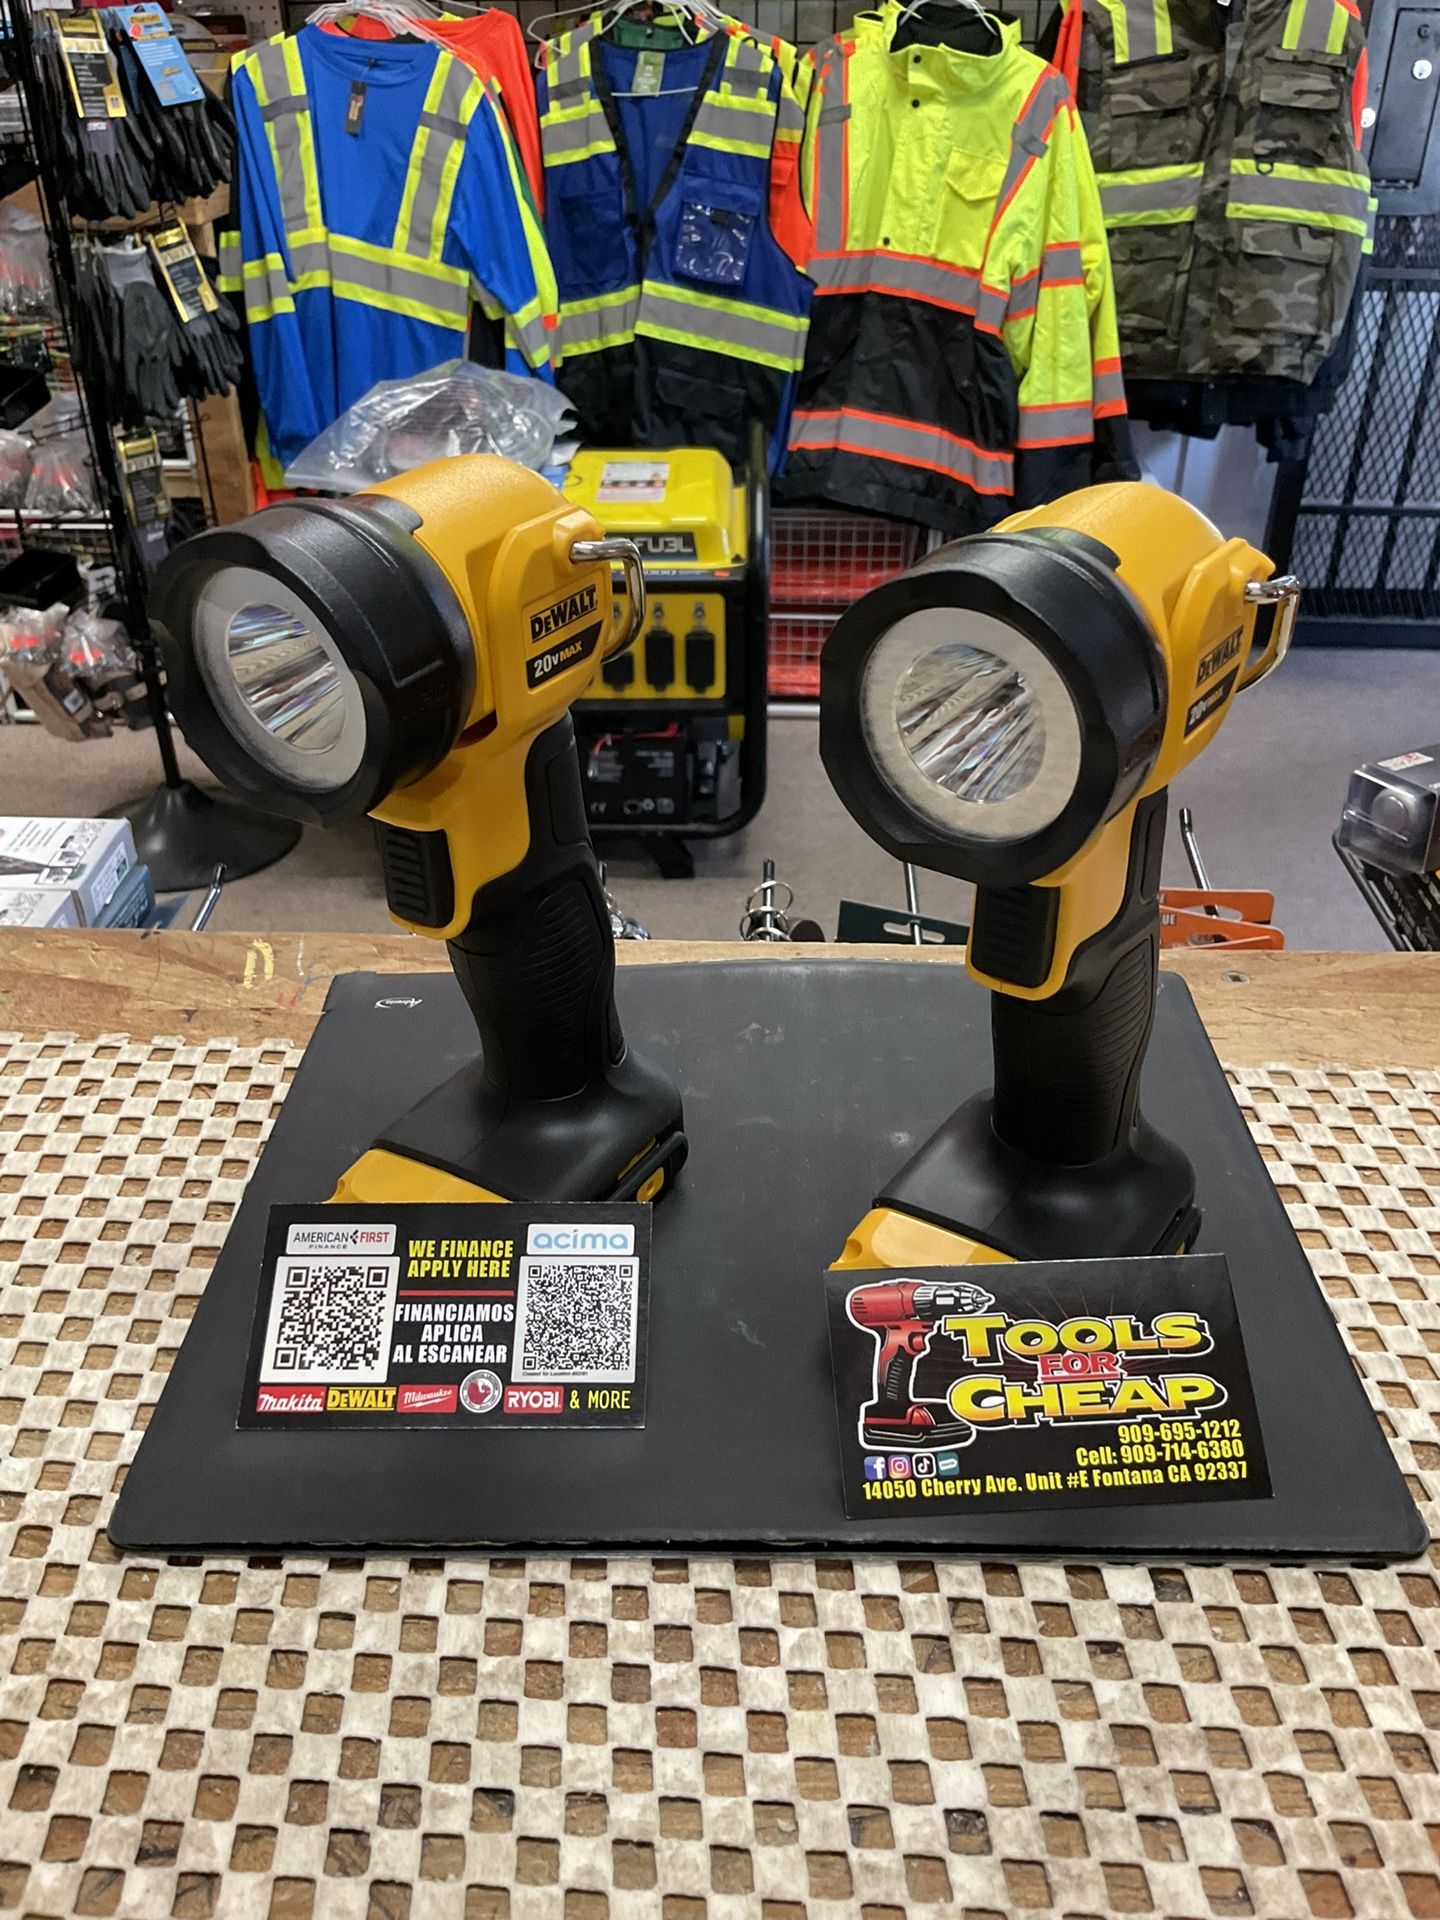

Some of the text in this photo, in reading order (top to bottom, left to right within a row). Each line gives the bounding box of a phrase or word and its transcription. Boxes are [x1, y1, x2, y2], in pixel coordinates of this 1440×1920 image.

[530, 585, 598, 642] DEWALT
[293, 1231, 390, 1243] AMERICAN FIRST
[533, 1229, 629, 1250] acima
[408, 1240, 514, 1258] WE FINANCE
[407, 1260, 511, 1278] APPLY HERE
[394, 1303, 515, 1322] FINANCIAMOS
[421, 1324, 484, 1343] APLICA
[944, 1312, 1210, 1362] TOOLS
[392, 1344, 508, 1363] AL ESCANEAR
[1038, 1350, 1119, 1377] FOR
[327, 1388, 397, 1410] DEWALT
[403, 1388, 453, 1405] Milwaukee
[508, 1391, 560, 1408] RYOBI
[569, 1389, 580, 1409] &
[588, 1390, 631, 1409] MORE
[948, 1374, 1222, 1424] CHEAP
[1117, 1418, 1242, 1444] 909-695-1212
[1075, 1438, 1245, 1467] Cell: 909-714-6380
[862, 1461, 1248, 1500] 14050 Cherry Ave. Unit #E Fontana CA 92337
